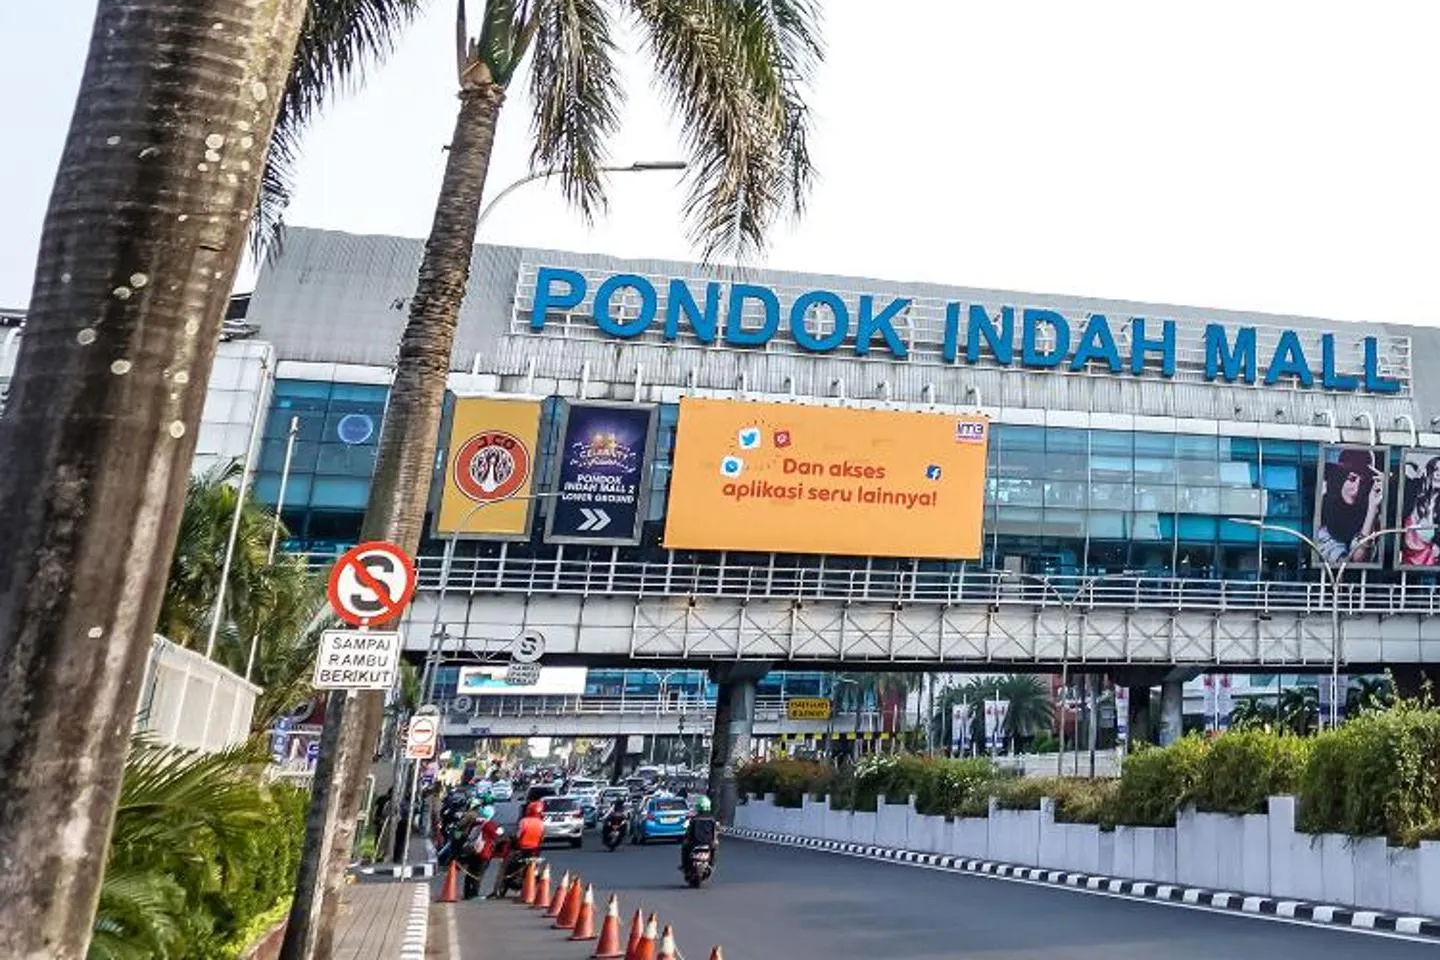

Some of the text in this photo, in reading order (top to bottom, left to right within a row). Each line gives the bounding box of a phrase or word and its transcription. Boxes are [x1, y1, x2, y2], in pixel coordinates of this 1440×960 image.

[530, 266, 1402, 394] PONDOK INDAH MALL
[782, 458, 886, 479] Dan akses
[627, 485, 636, 495] 2
[722, 480, 938, 510] aplikasi seru lainnya!
[350, 554, 394, 611] S
[332, 637, 391, 652] SAMPAI
[328, 654, 389, 668] RAMBU
[319, 669, 391, 683] BERIKUT
